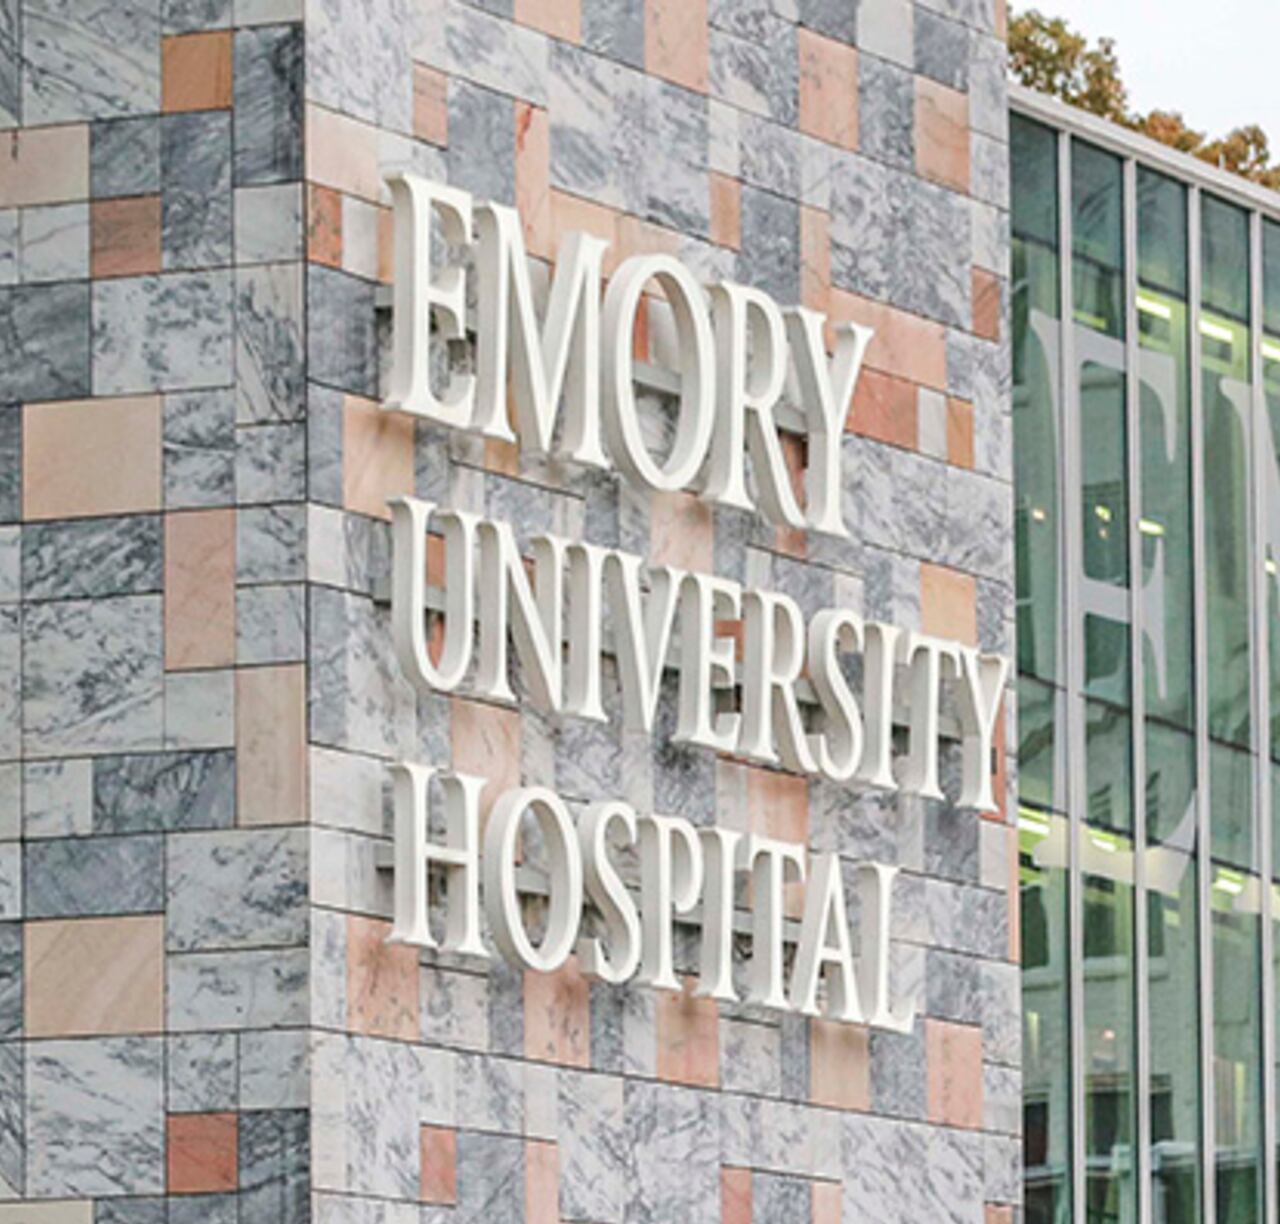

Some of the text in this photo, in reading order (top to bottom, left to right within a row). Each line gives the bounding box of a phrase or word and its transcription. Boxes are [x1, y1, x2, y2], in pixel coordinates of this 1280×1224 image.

[380, 168, 874, 538] EMORY
[387, 496, 1010, 815] UNIVERSITY
[384, 761, 922, 1034] HOSPITAL
